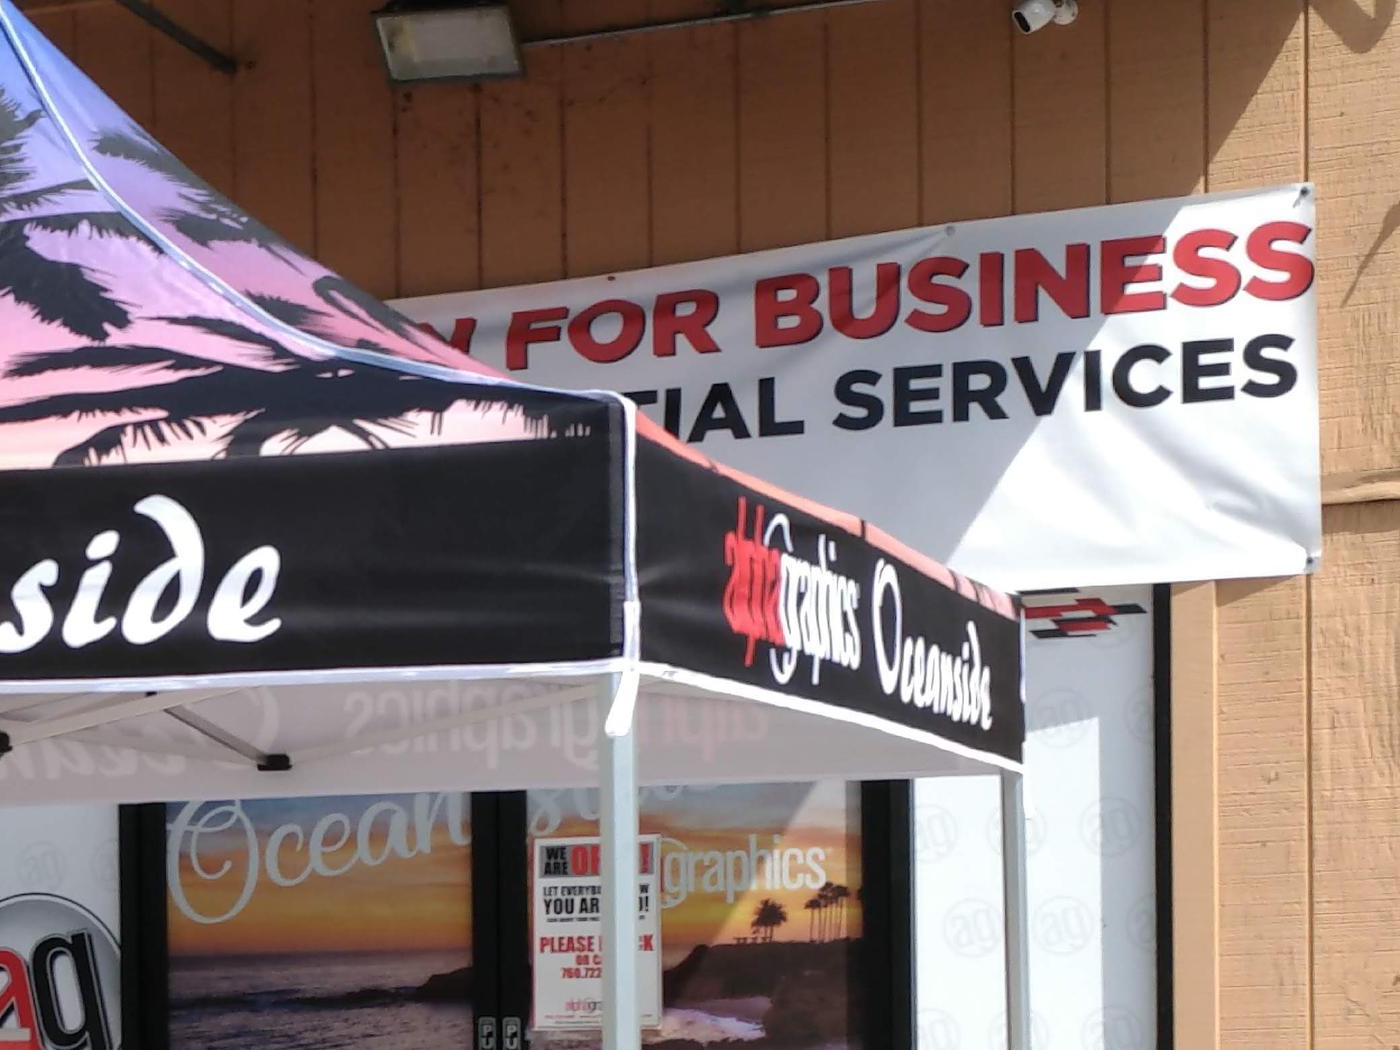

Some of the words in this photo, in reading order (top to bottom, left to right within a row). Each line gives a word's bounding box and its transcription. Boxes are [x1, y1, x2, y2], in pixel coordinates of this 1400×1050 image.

[505, 289, 722, 370] FOR
[754, 220, 1315, 348] BUSINESS
[832, 333, 1298, 431] SERVICES
[871, 557, 993, 731] Oceanside
[546, 846, 568, 861] WE
[544, 861, 569, 876] ARE
[543, 886, 559, 897] LET
[544, 898, 575, 915] YOU
[579, 897, 601, 914] AR
[539, 935, 595, 953] PLEASE
